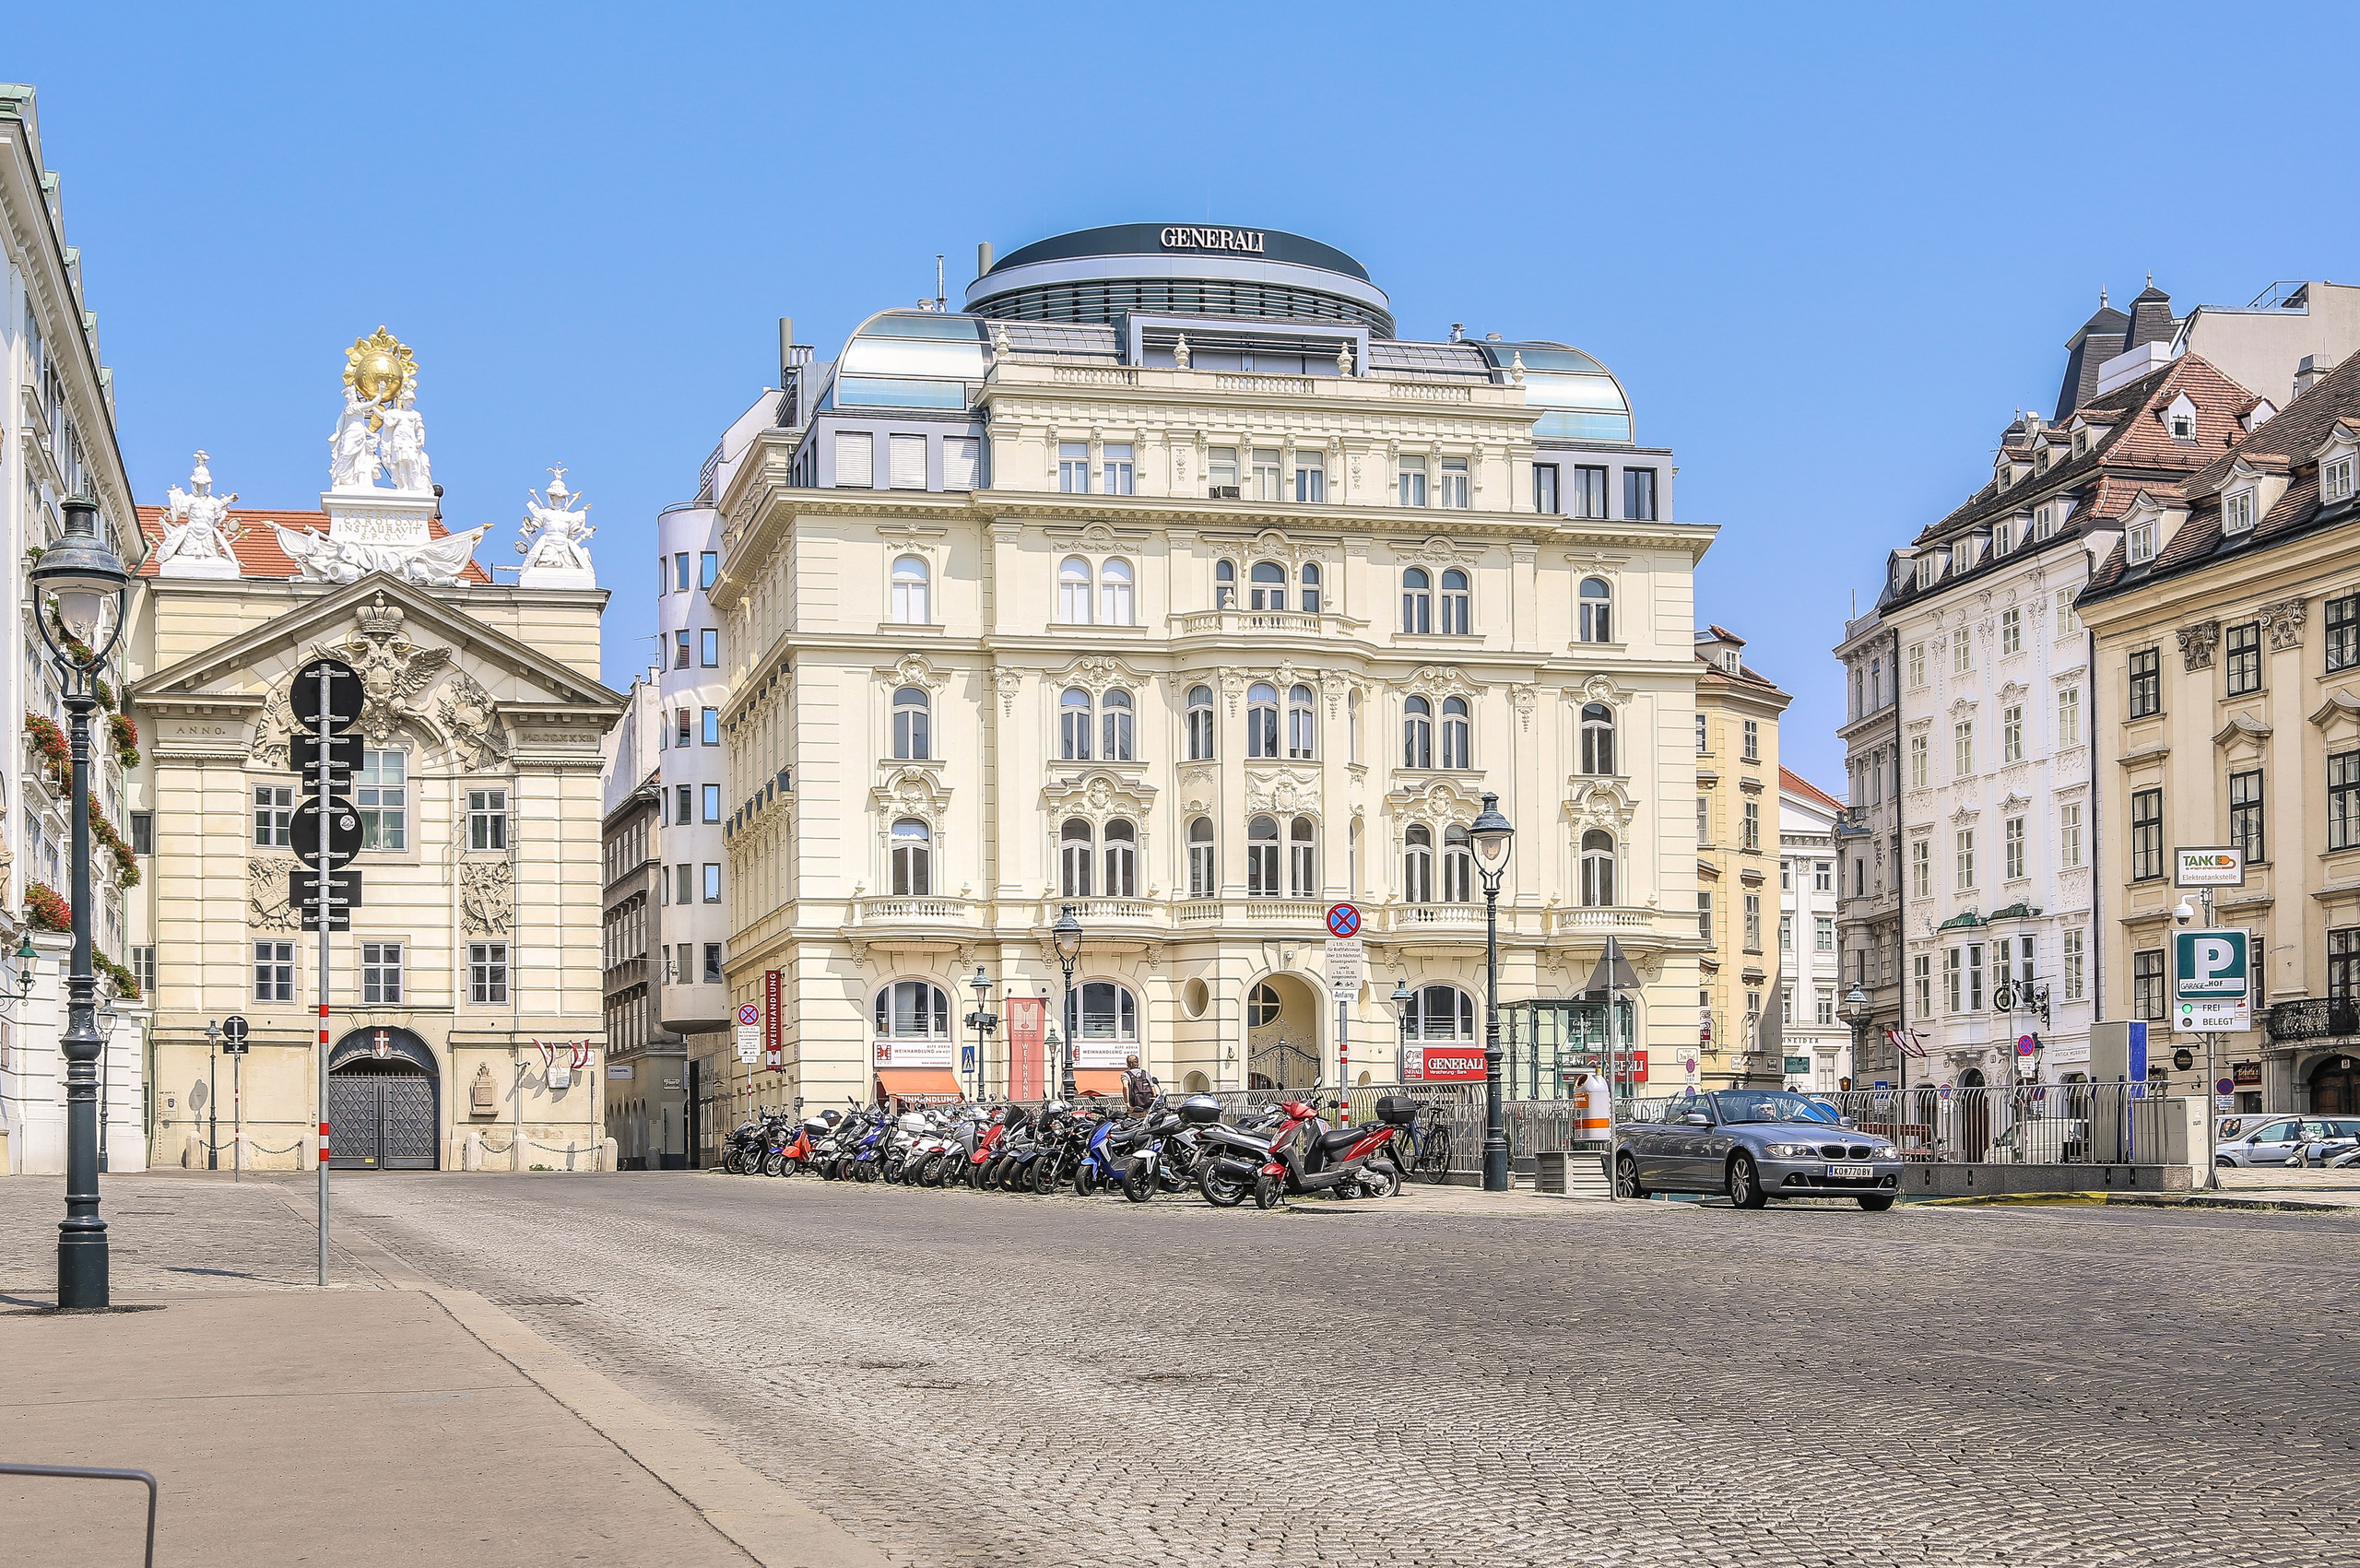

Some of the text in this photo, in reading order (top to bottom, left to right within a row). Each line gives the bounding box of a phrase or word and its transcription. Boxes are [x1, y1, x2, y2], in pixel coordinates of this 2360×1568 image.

[1161, 227, 1264, 253] GENERALI
[338, 525, 421, 535] INSTAURAVIT
[1334, 991, 1355, 1000] Anfang
[2202, 1018, 2235, 1026] BELEGT
[1428, 1058, 1484, 1069] GENERALI
